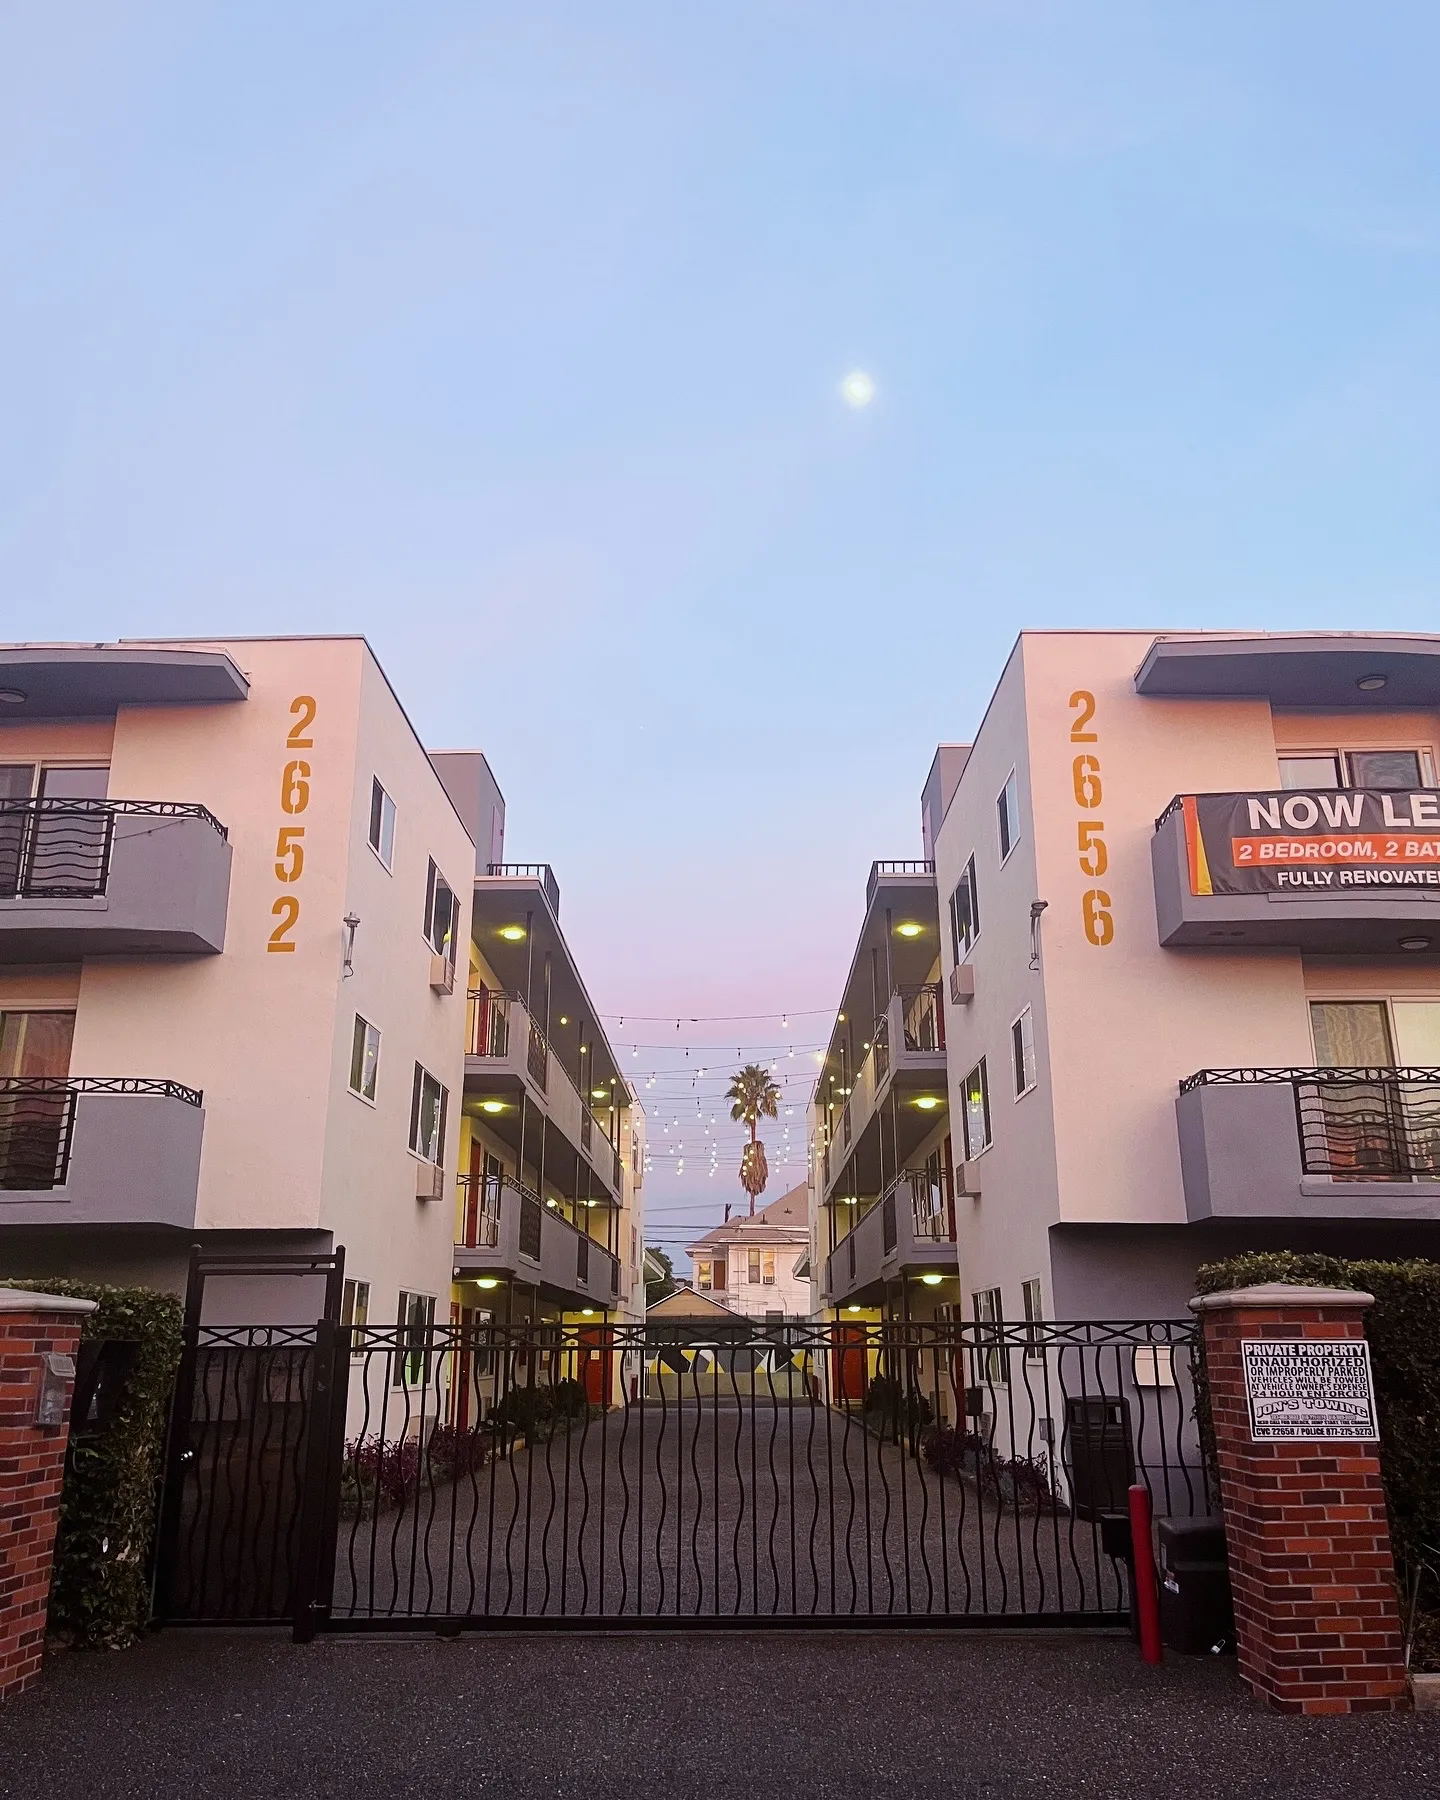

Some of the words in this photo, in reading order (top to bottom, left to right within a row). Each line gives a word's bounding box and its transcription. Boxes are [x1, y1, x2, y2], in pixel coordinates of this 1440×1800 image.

[1068, 690, 1114, 946] 2656
[1247, 794, 1364, 830] NOW
[1381, 794, 1440, 828] LE
[266, 695, 317, 953] 2652
[1239, 845, 1253, 860] 2
[1259, 841, 1378, 860] BEDROOM,
[1384, 841, 1399, 858] 2
[1277, 871, 1334, 886] FULLY
[1340, 870, 1440, 885] RENOVATE
[1244, 1344, 1297, 1356] PRIVATE
[1298, 1344, 1363, 1356] PROPERTY
[1249, 1357, 1364, 1367] UNAUTHORIZED
[1250, 1367, 1264, 1376] OR
[1266, 1367, 1326, 1376] IMPROPERLY
[1328, 1367, 1365, 1376] PARKED
[1251, 1383, 1261, 1391] AT
[1262, 1383, 1293, 1391] VEHICLE
[1295, 1383, 1331, 1391] OWNER'S
[1333, 1383, 1367, 1391] EXPENSE
[1256, 1398, 1300, 1418] JON'S
[1302, 1398, 1368, 1418] TOWING
[1256, 1428, 1271, 1436] CVC
[1272, 1428, 1295, 1436] 22658
[1301, 1428, 1325, 1436] POLICE
